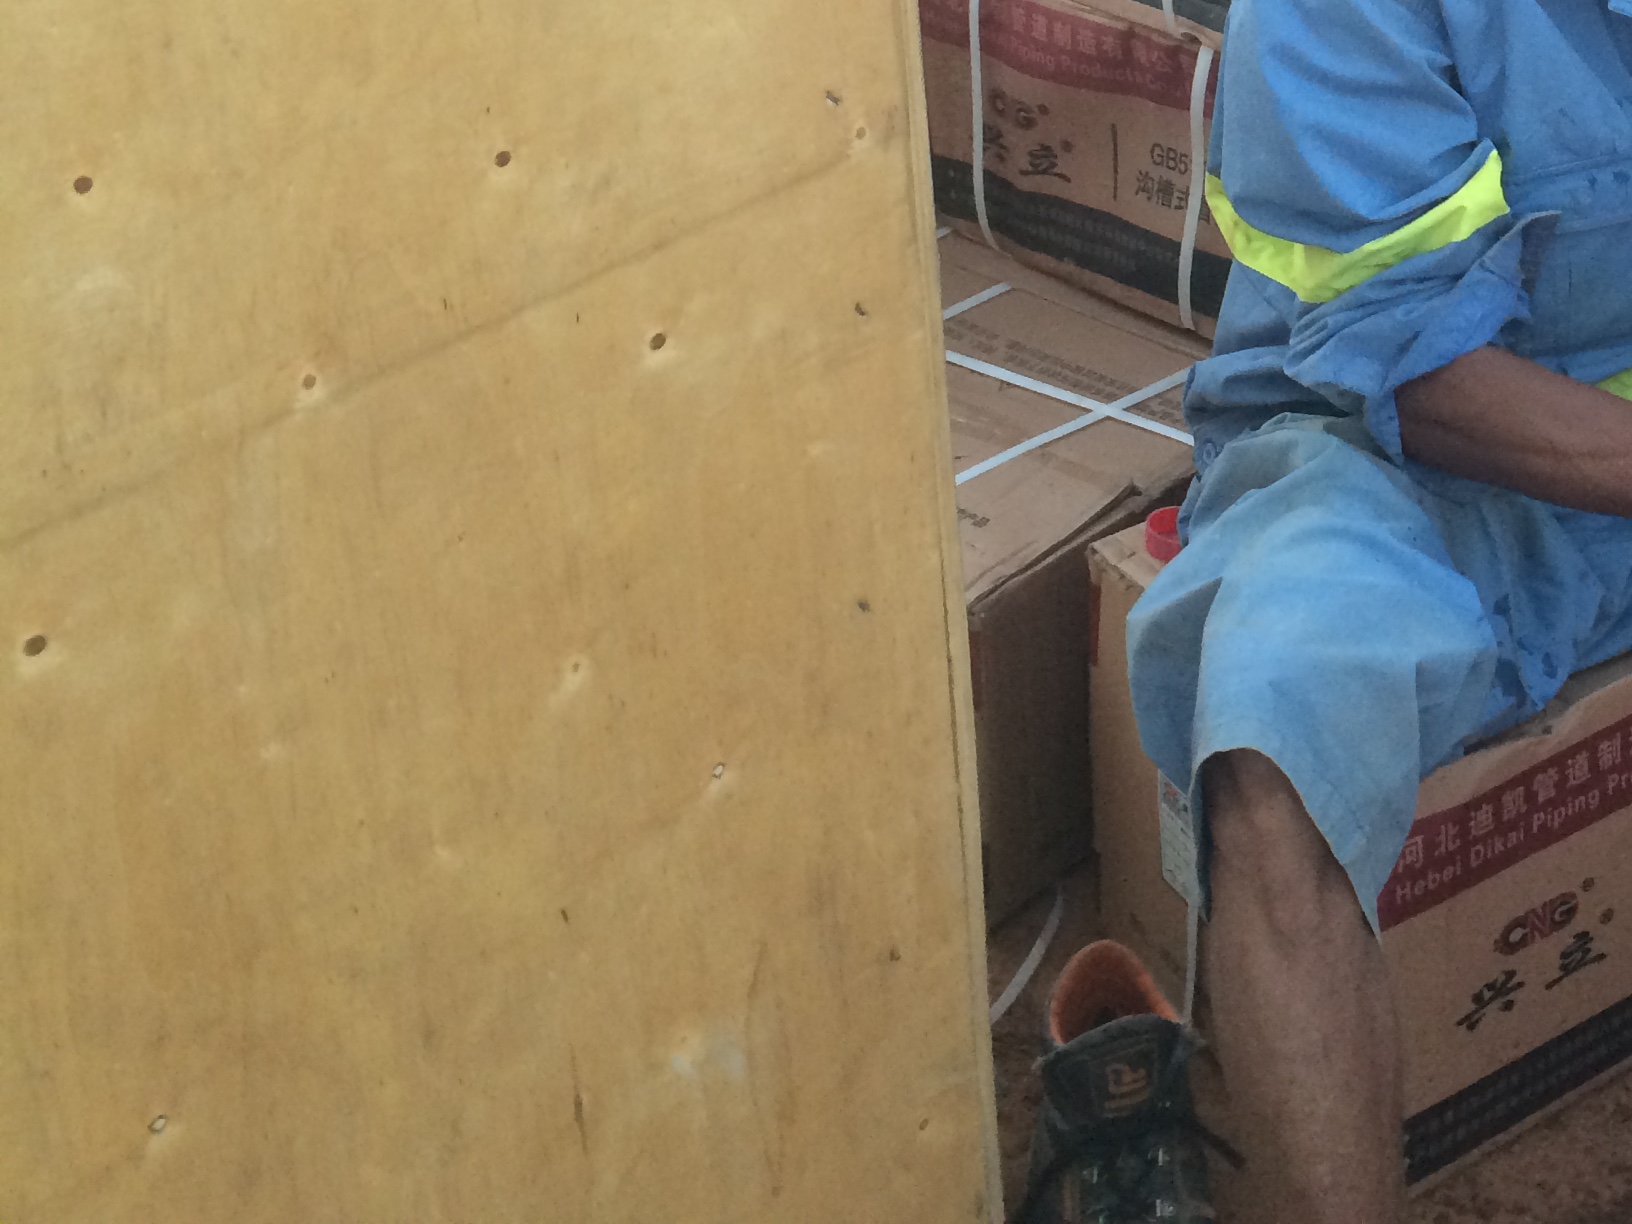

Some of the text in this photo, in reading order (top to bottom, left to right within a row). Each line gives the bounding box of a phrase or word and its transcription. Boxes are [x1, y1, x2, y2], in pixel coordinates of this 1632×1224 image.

[1395, 860, 1462, 906] Hebei
[1469, 828, 1525, 870] Dikai
[1531, 788, 1601, 836] Piping
[1492, 890, 1580, 956] CNG
